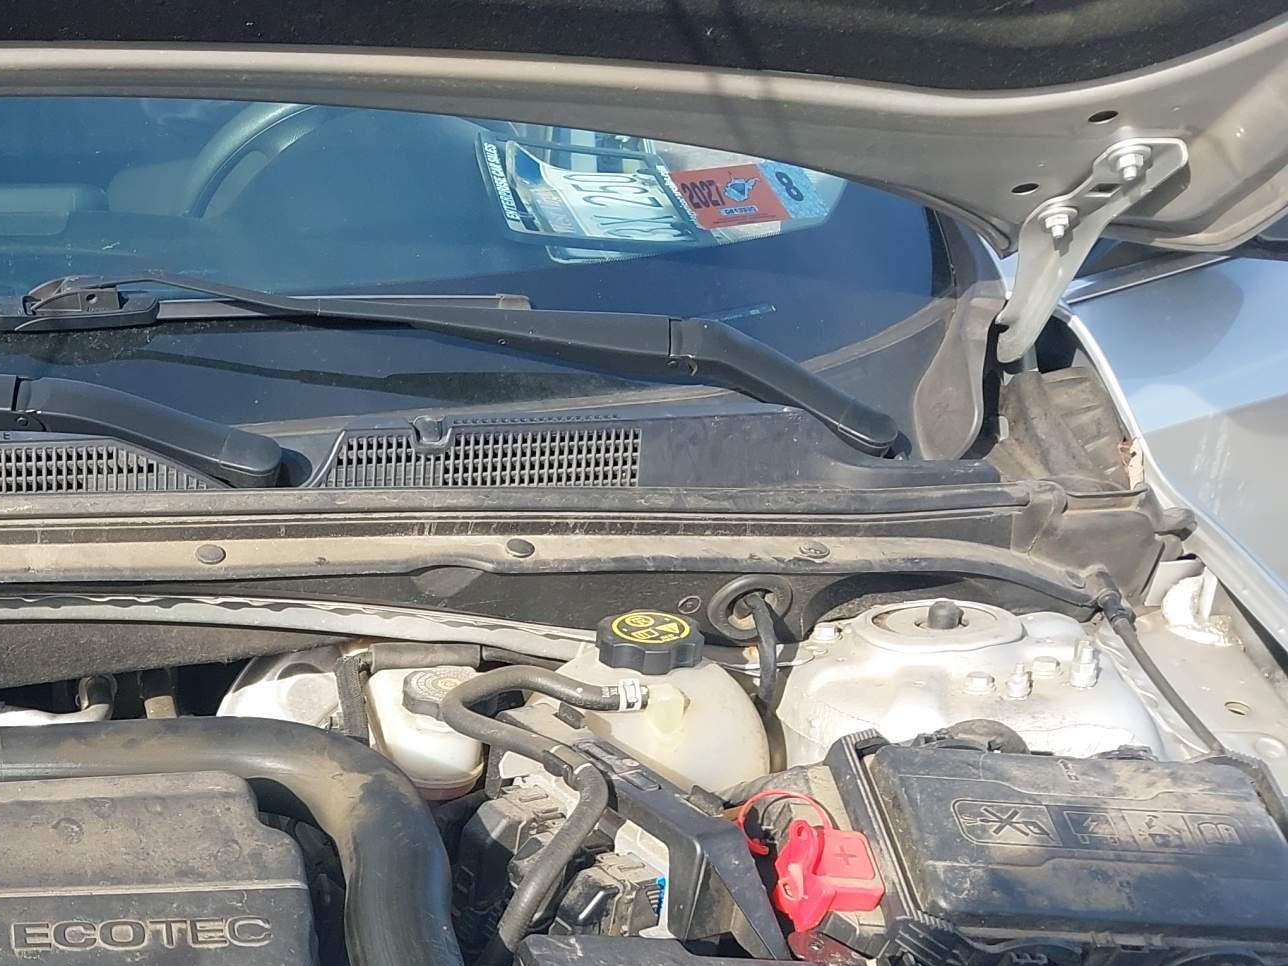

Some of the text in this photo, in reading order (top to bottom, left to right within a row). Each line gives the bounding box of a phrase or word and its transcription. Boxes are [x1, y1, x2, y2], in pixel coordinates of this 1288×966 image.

[484, 143, 520, 221] ENTERPRISE CAR SALES
[563, 174, 664, 208] 250
[680, 180, 726, 209] 2027
[775, 171, 804, 202] 8
[12, 916, 272, 950] ECOTEC
